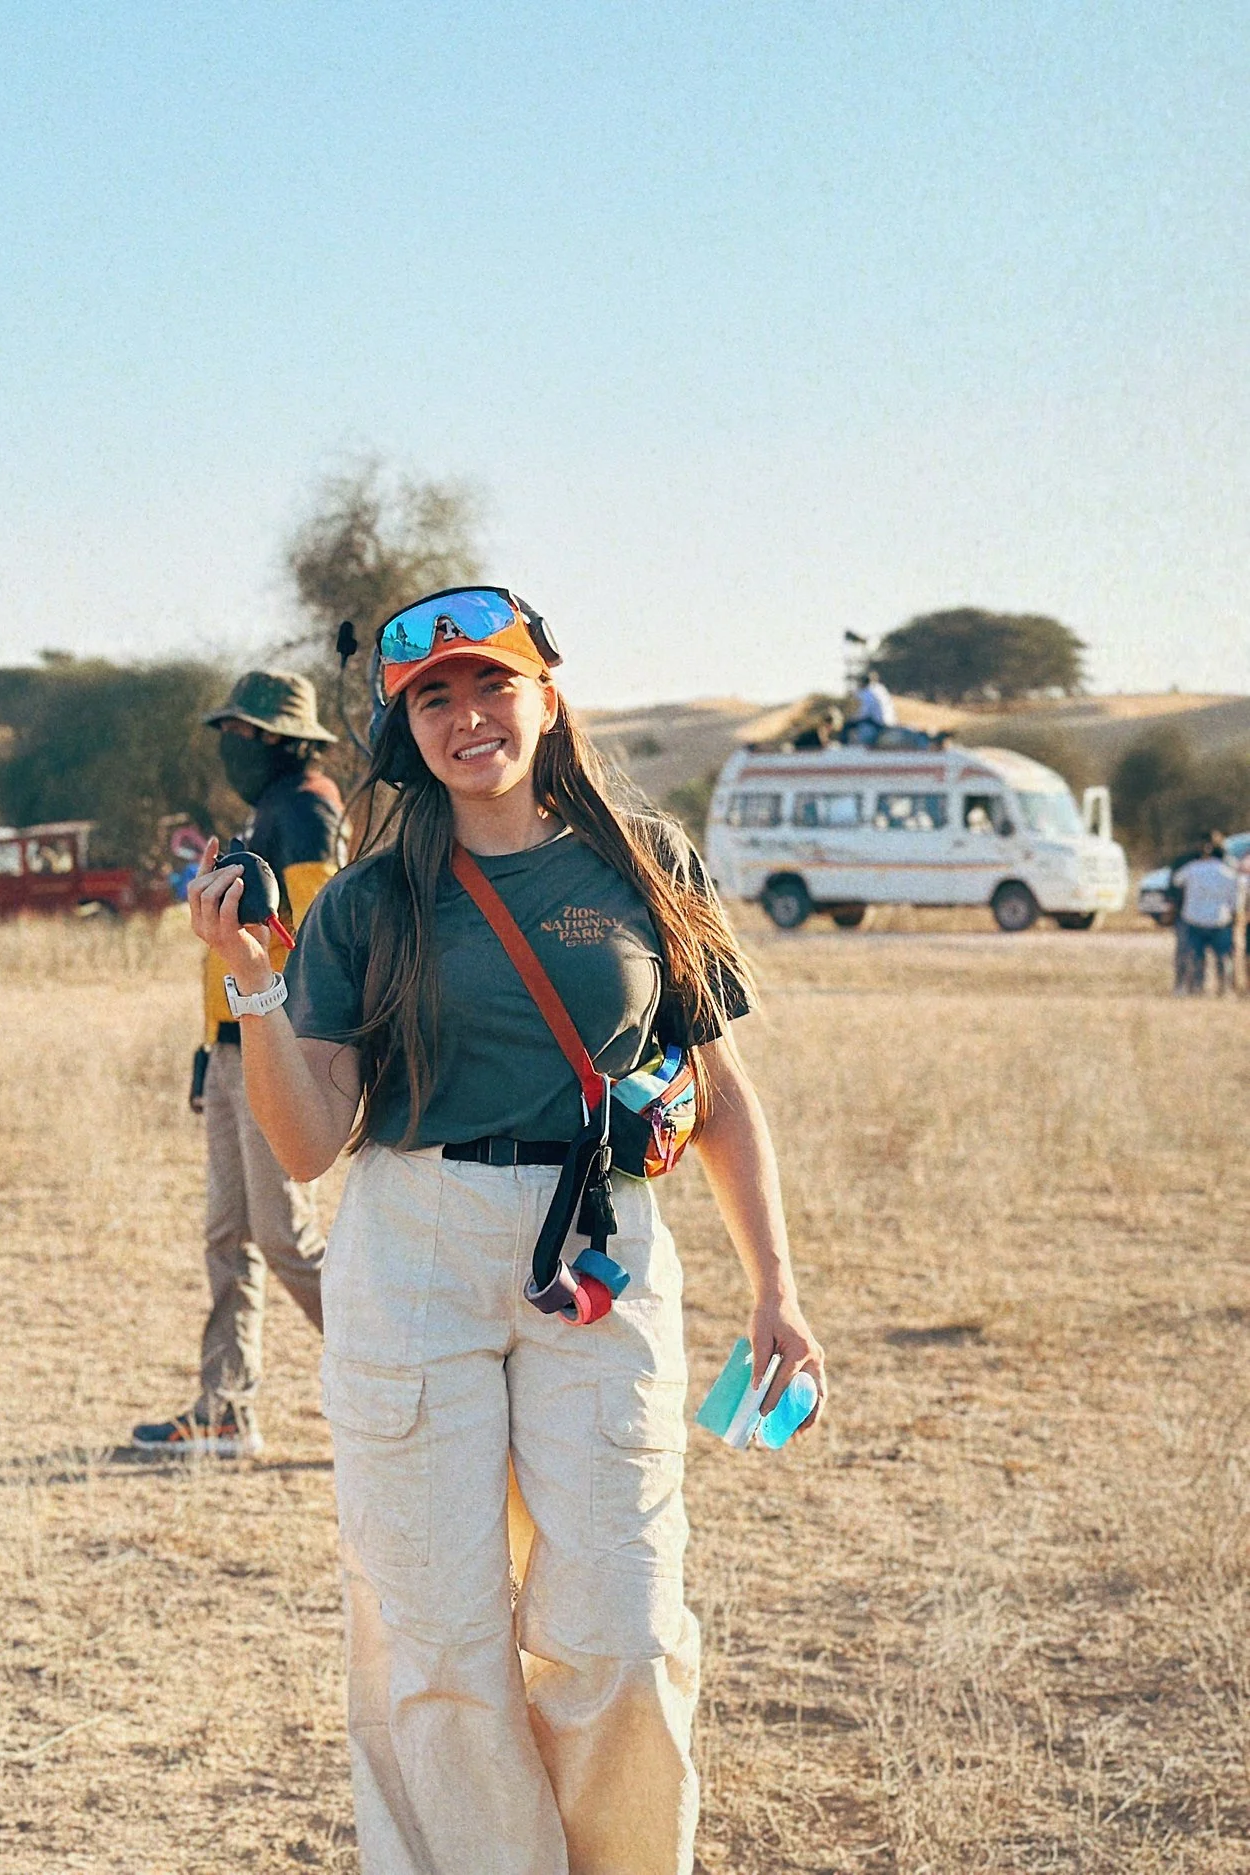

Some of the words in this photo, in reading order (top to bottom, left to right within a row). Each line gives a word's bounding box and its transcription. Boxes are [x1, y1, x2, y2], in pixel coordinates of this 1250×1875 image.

[562, 905, 600, 919] ZION
[540, 917, 621, 932] NATIONAL
[558, 928, 606, 942] PARK
